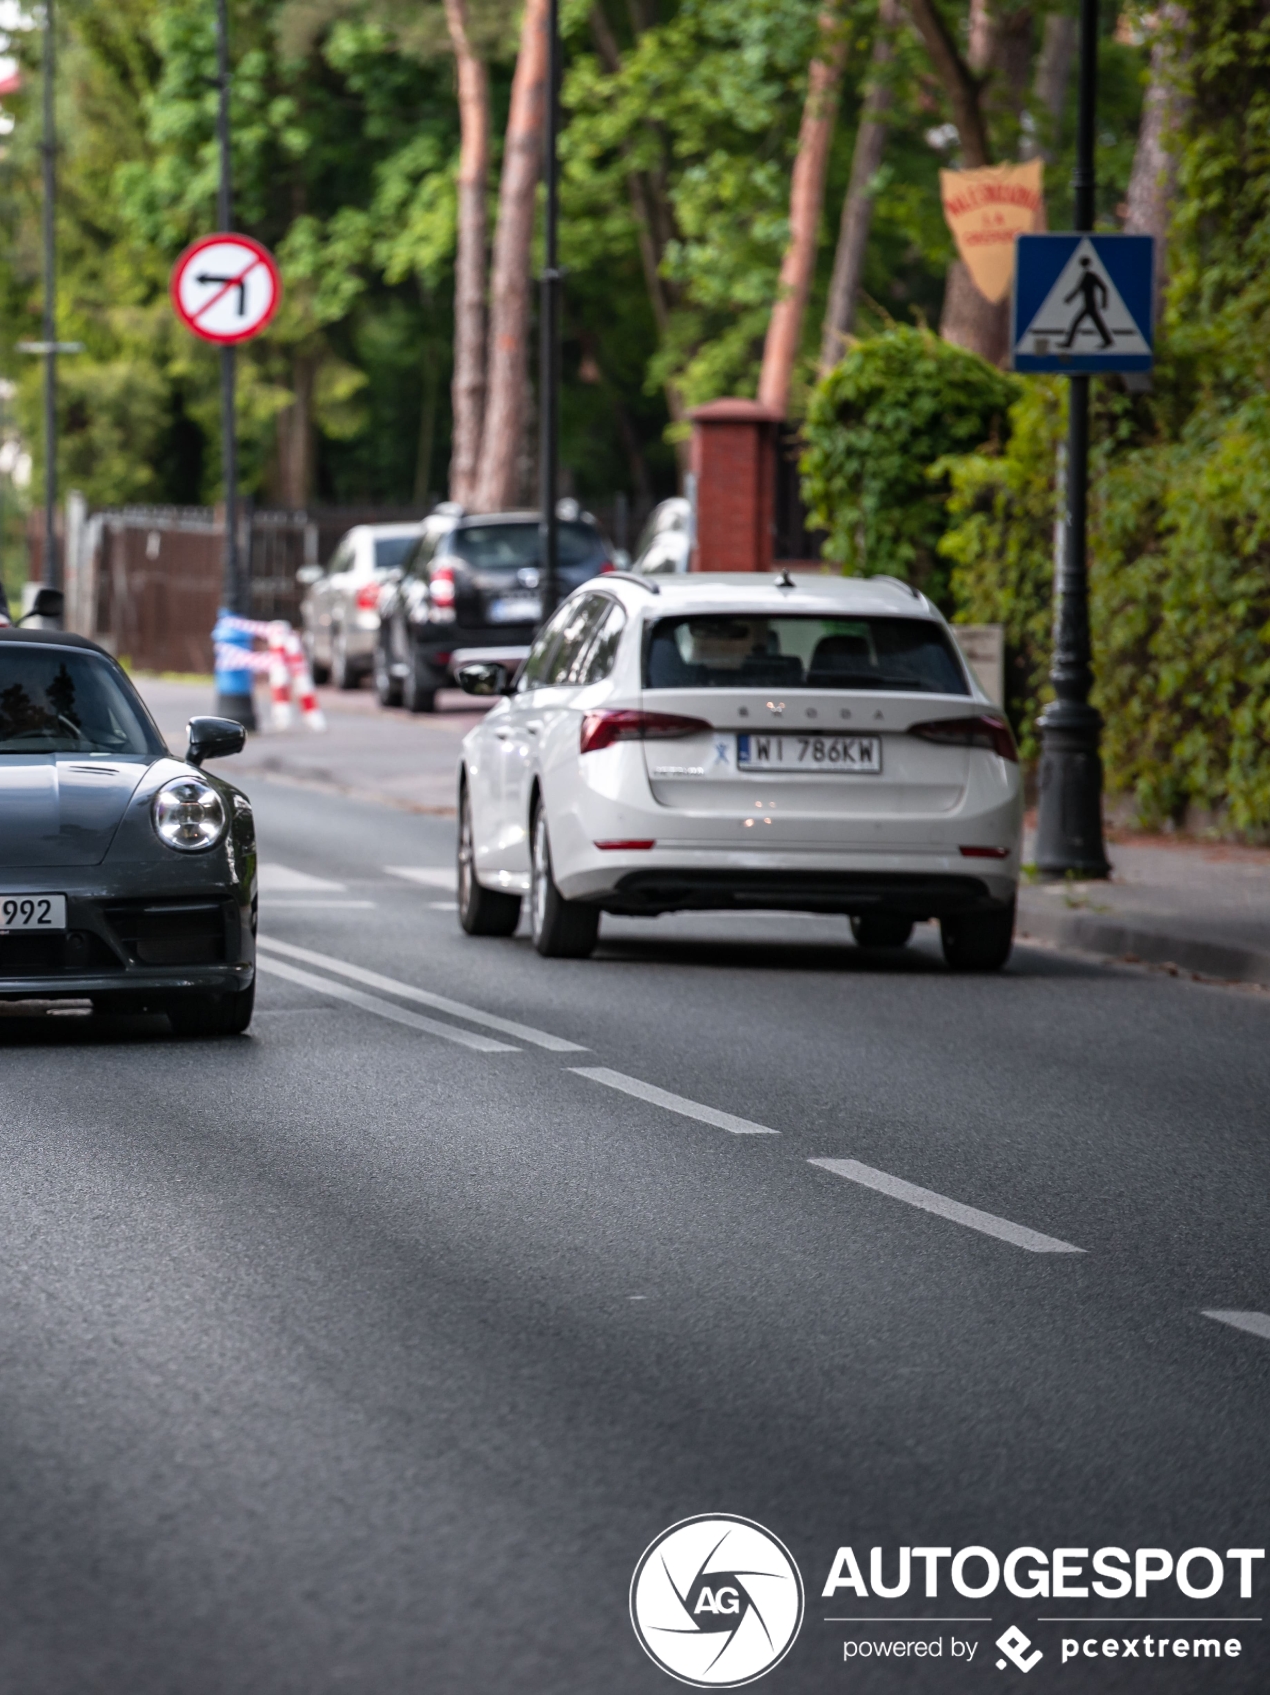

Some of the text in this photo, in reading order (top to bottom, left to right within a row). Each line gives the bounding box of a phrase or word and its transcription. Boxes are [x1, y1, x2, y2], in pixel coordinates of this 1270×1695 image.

[755, 738, 874, 764] WI 786KW
[3, 899, 52, 925] 992
